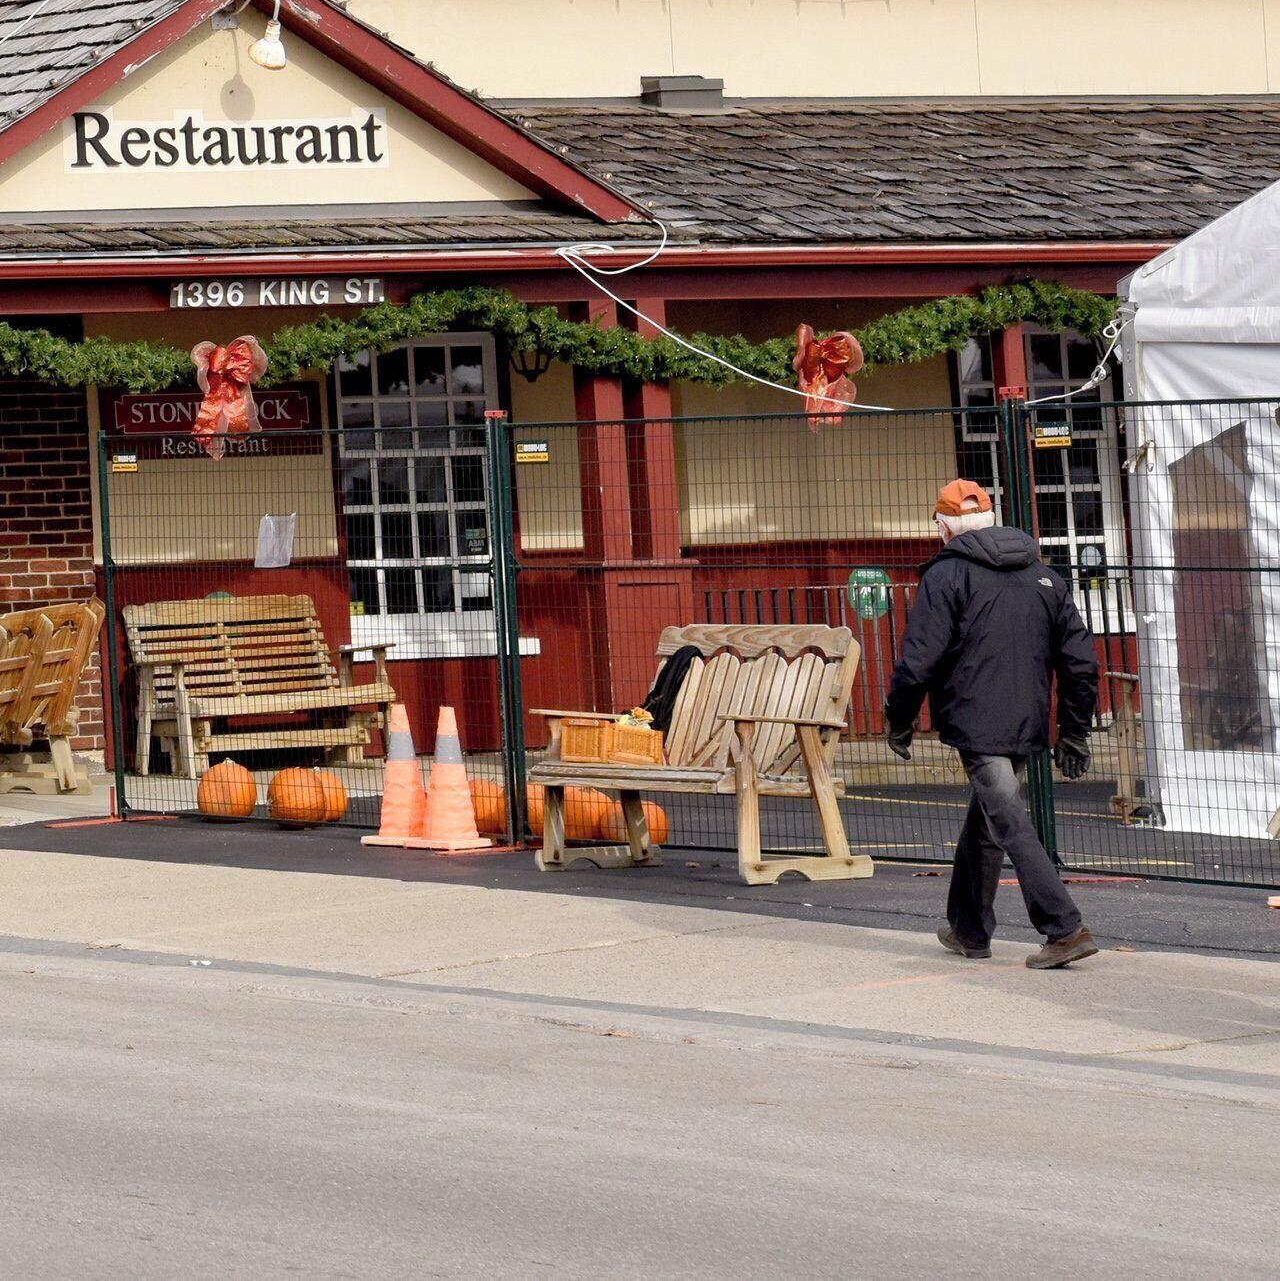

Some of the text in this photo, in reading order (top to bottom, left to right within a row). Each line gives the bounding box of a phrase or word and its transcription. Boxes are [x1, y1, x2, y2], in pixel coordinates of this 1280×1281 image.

[70, 111, 384, 168] Restaurant
[172, 278, 385, 308] 1396 KING ST.
